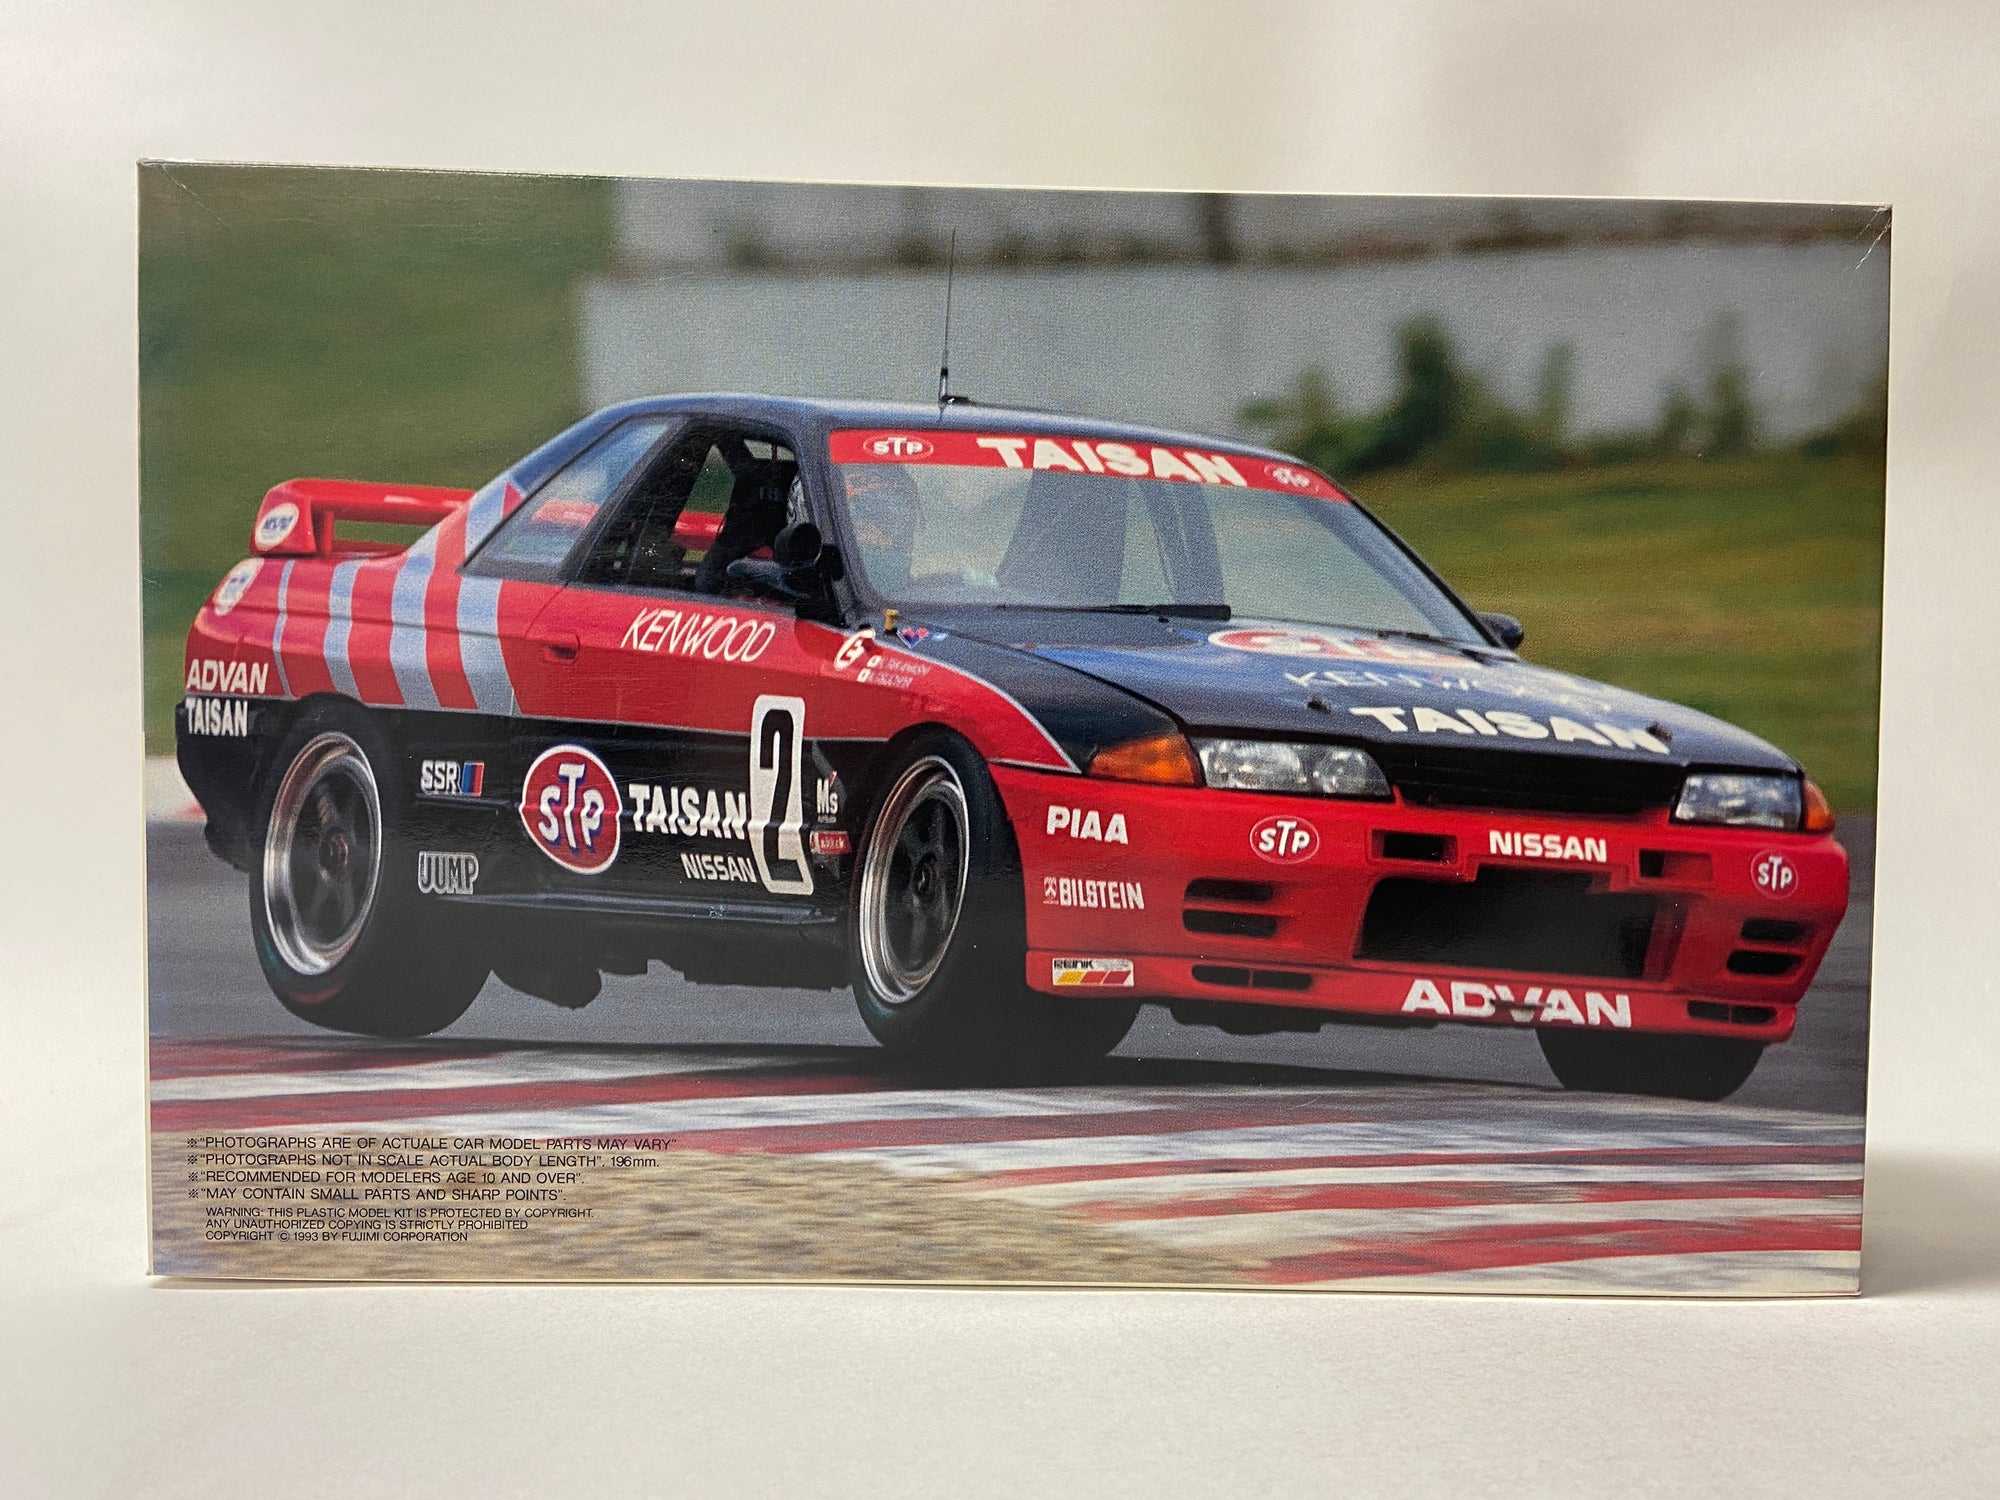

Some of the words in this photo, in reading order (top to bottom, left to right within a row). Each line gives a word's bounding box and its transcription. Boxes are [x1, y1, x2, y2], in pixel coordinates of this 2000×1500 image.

[873, 437, 923, 457] STP
[976, 437, 1248, 486] TAISAN
[621, 607, 777, 662] KENWOOD
[186, 659, 268, 693] ADVAN
[185, 698, 248, 737] TAISAN
[1349, 707, 1670, 754] TAISAN
[421, 760, 459, 795] SSR
[757, 703, 807, 886] 2
[538, 763, 605, 848] STP
[628, 783, 747, 840] TAISAN
[1046, 805, 1129, 845] PIAA
[1258, 820, 1310, 857] STP
[1489, 830, 1607, 863] NISSAN
[418, 851, 479, 894] JUMP
[680, 852, 757, 883] NISSAN
[1757, 856, 1793, 891] STP
[1059, 877, 1145, 910] BILSTEIN
[1401, 978, 1632, 1028] ADVAN
[322, 1137, 351, 1150] ARE
[357, 1137, 376, 1150] OF
[382, 1137, 447, 1151] ACTUALE
[453, 1137, 484, 1151] CAR
[489, 1137, 540, 1151] MODEL
[546, 1137, 592, 1151] PARTS
[597, 1138, 627, 1151] MAY
[322, 1154, 352, 1167] NOT
[358, 1154, 371, 1167] IN
[377, 1154, 423, 1168] SCALE
[430, 1154, 486, 1168] ACTUAL
[492, 1154, 533, 1168] BODY
[611, 1155, 660, 1168] 196mm.
[243, 1188, 305, 1201] CONTAIN
[310, 1188, 359, 1201] SMALL
[364, 1188, 410, 1201] PARTS
[416, 1188, 446, 1202] AND
[451, 1188, 500, 1202] SHARP
[326, 1171, 355, 1184] FOR
[361, 1171, 441, 1185] MODELERS
[447, 1171, 476, 1185] AGE
[482, 1171, 495, 1185] 10
[501, 1171, 530, 1185] AND
[206, 1207, 264, 1218] WARNING:
[267, 1207, 293, 1218] THIS
[296, 1207, 345, 1218] PLASTIC
[348, 1207, 390, 1218] MODEL
[394, 1207, 412, 1219] KIT
[416, 1207, 426, 1219] IS
[430, 1207, 501, 1219] PROTECTED
[505, 1207, 520, 1219] BY
[525, 1207, 594, 1219] COPYRIGHT.
[206, 1219, 229, 1230] ANY
[233, 1219, 325, 1230] UNAUTHORIZED
[328, 1219, 381, 1230] COPYING
[385, 1219, 396, 1230] IS
[399, 1219, 453, 1231] STRICTLY
[458, 1219, 528, 1231] PROHIBITED
[206, 1231, 273, 1242] COPYRIGHT
[294, 1231, 319, 1242] 1993
[322, 1231, 339, 1242] BY
[342, 1231, 379, 1242] FUJIMI
[383, 1231, 467, 1242] CORPORATION
